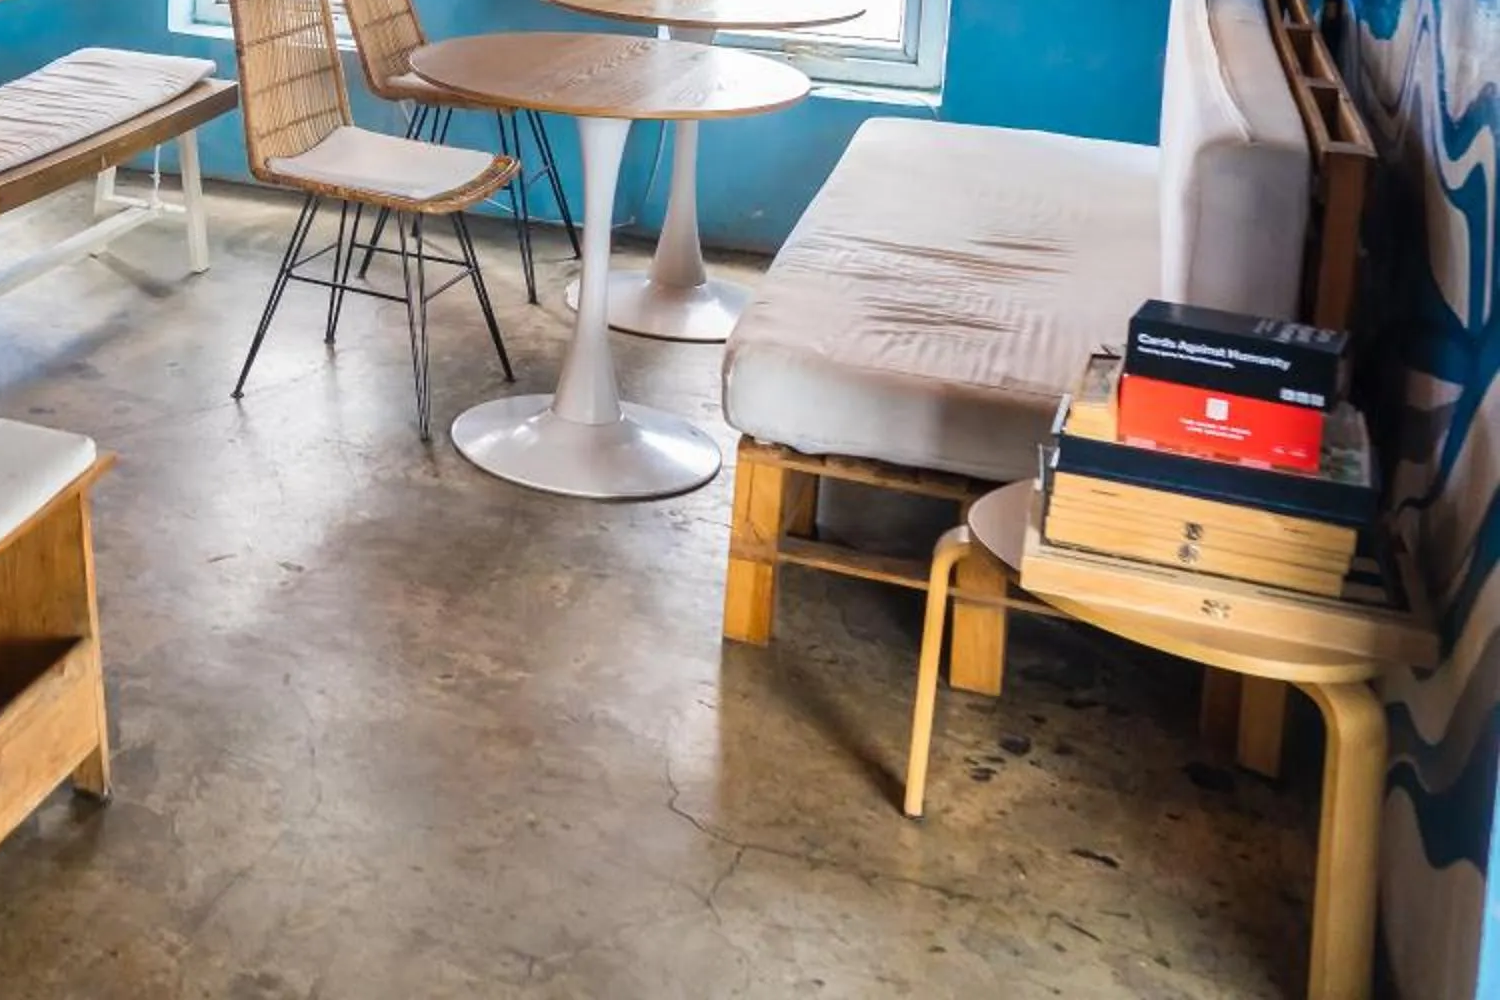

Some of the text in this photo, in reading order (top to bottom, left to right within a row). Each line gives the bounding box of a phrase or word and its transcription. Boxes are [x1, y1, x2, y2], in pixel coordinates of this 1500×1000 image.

[1137, 333, 1177, 349] Cards
[1177, 340, 1227, 359] Against
[1227, 348, 1292, 372] Humanity
